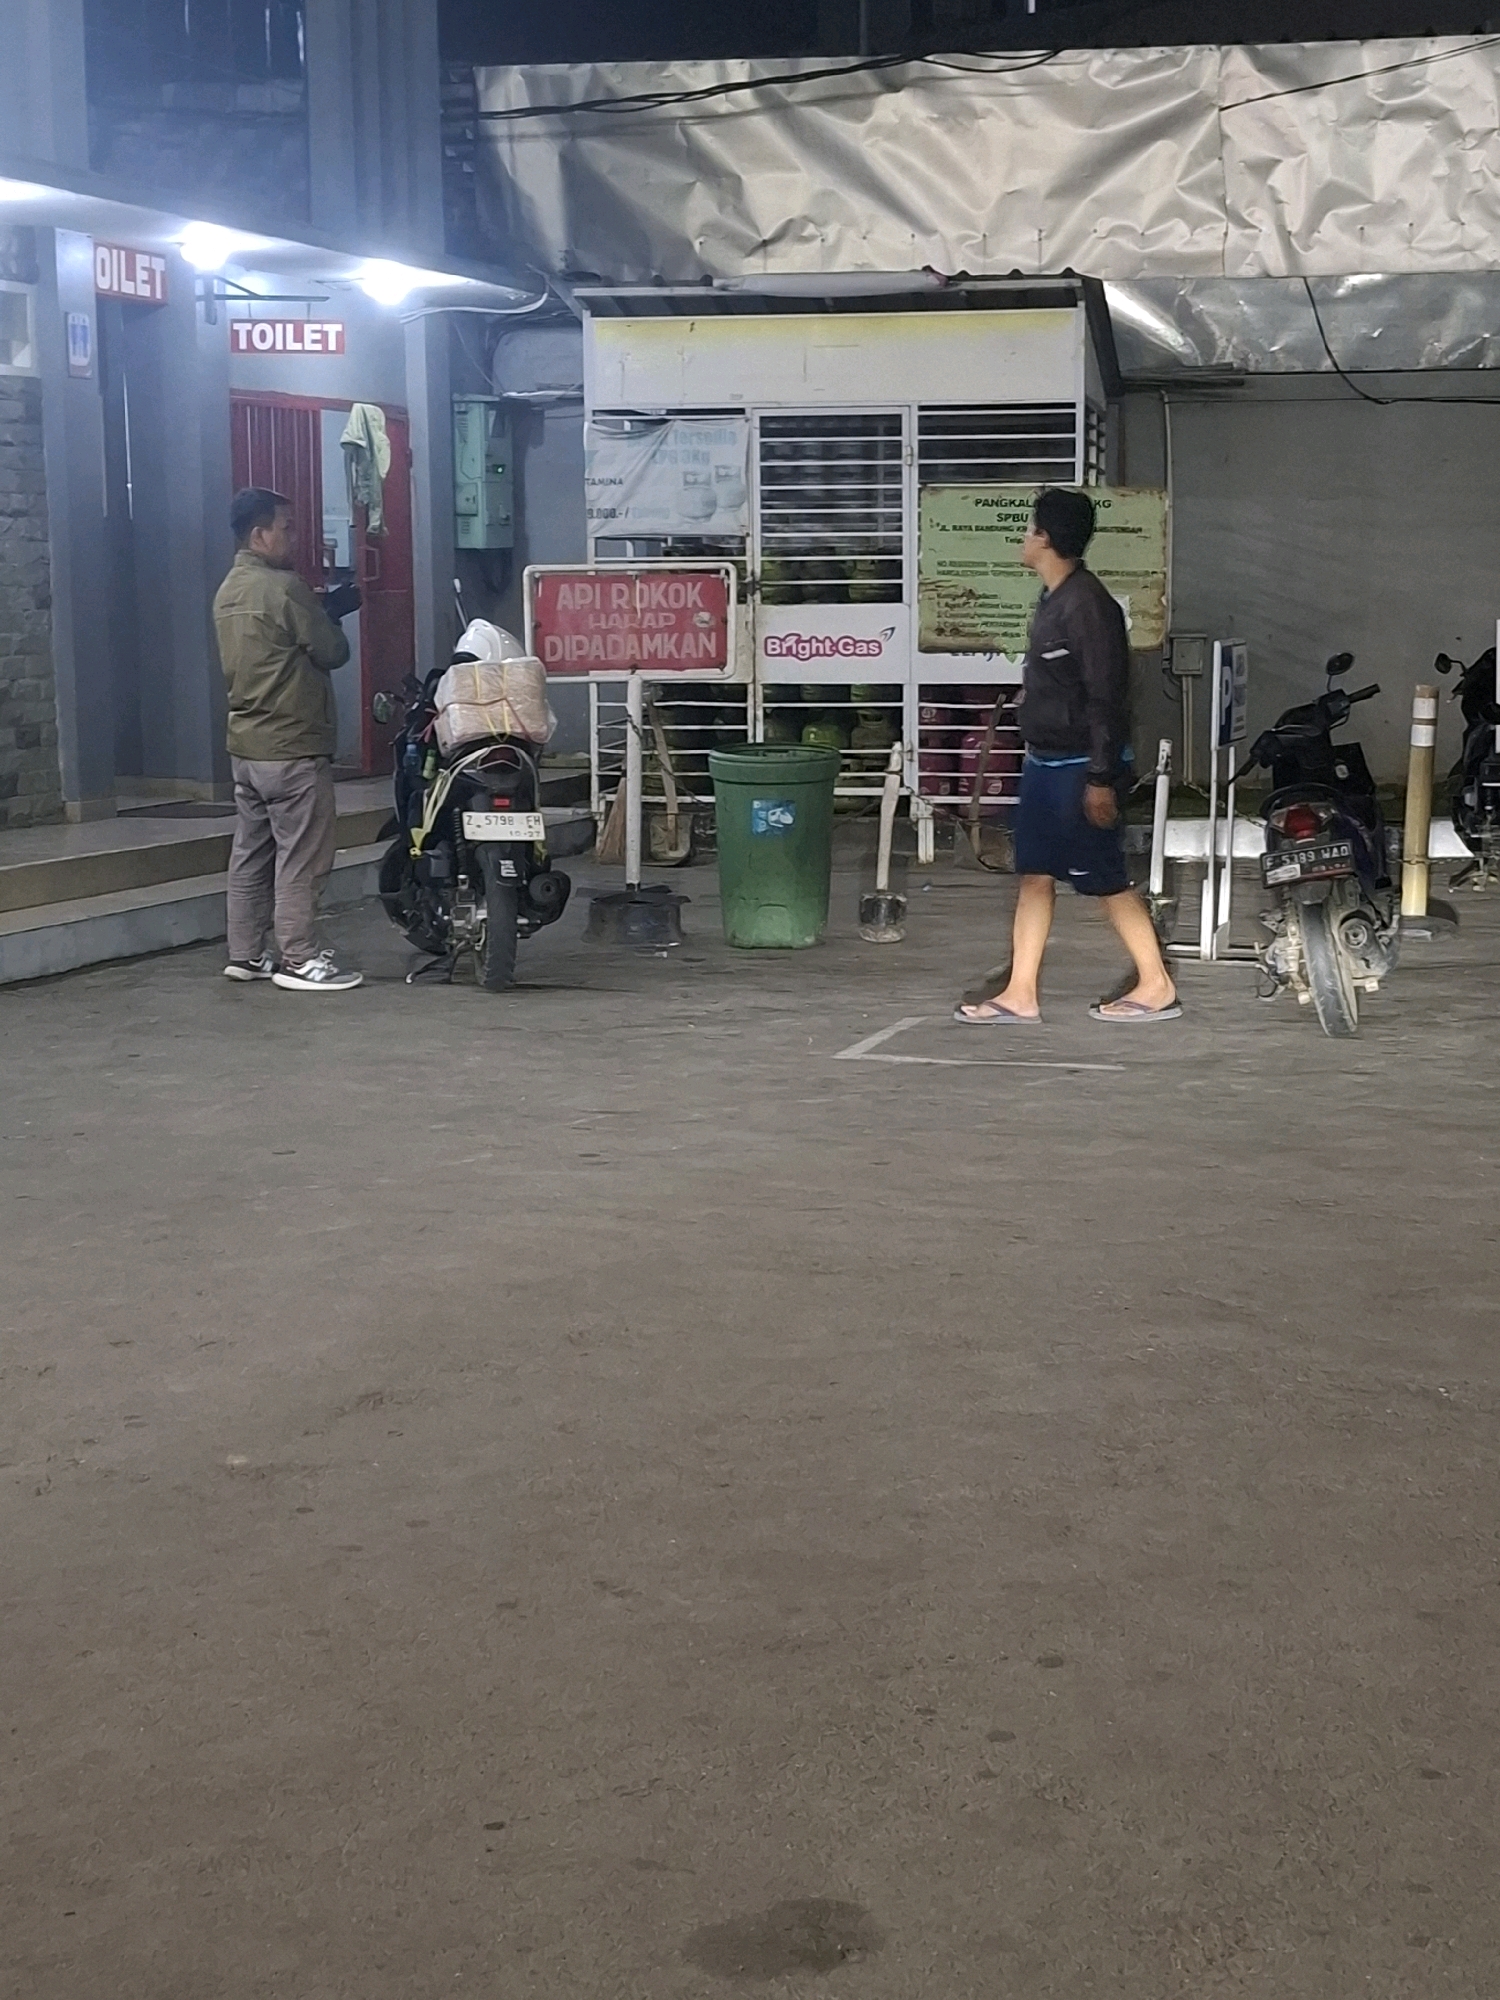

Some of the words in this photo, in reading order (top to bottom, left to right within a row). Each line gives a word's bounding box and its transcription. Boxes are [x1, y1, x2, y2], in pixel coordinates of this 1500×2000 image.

[96, 246, 165, 299] OILET
[233, 323, 342, 351] TOILET
[974, 498, 1036, 508] PANGKAL
[996, 512, 1029, 523] SPBU
[556, 583, 601, 610] API
[611, 582, 704, 609] ROKOK
[588, 613, 676, 629] HARAP
[544, 632, 716, 662] DIPADAMKAN
[766, 633, 833, 660] Bright
[837, 636, 883, 657] Gas
[466, 814, 473, 825] Z
[484, 815, 514, 826] 5798
